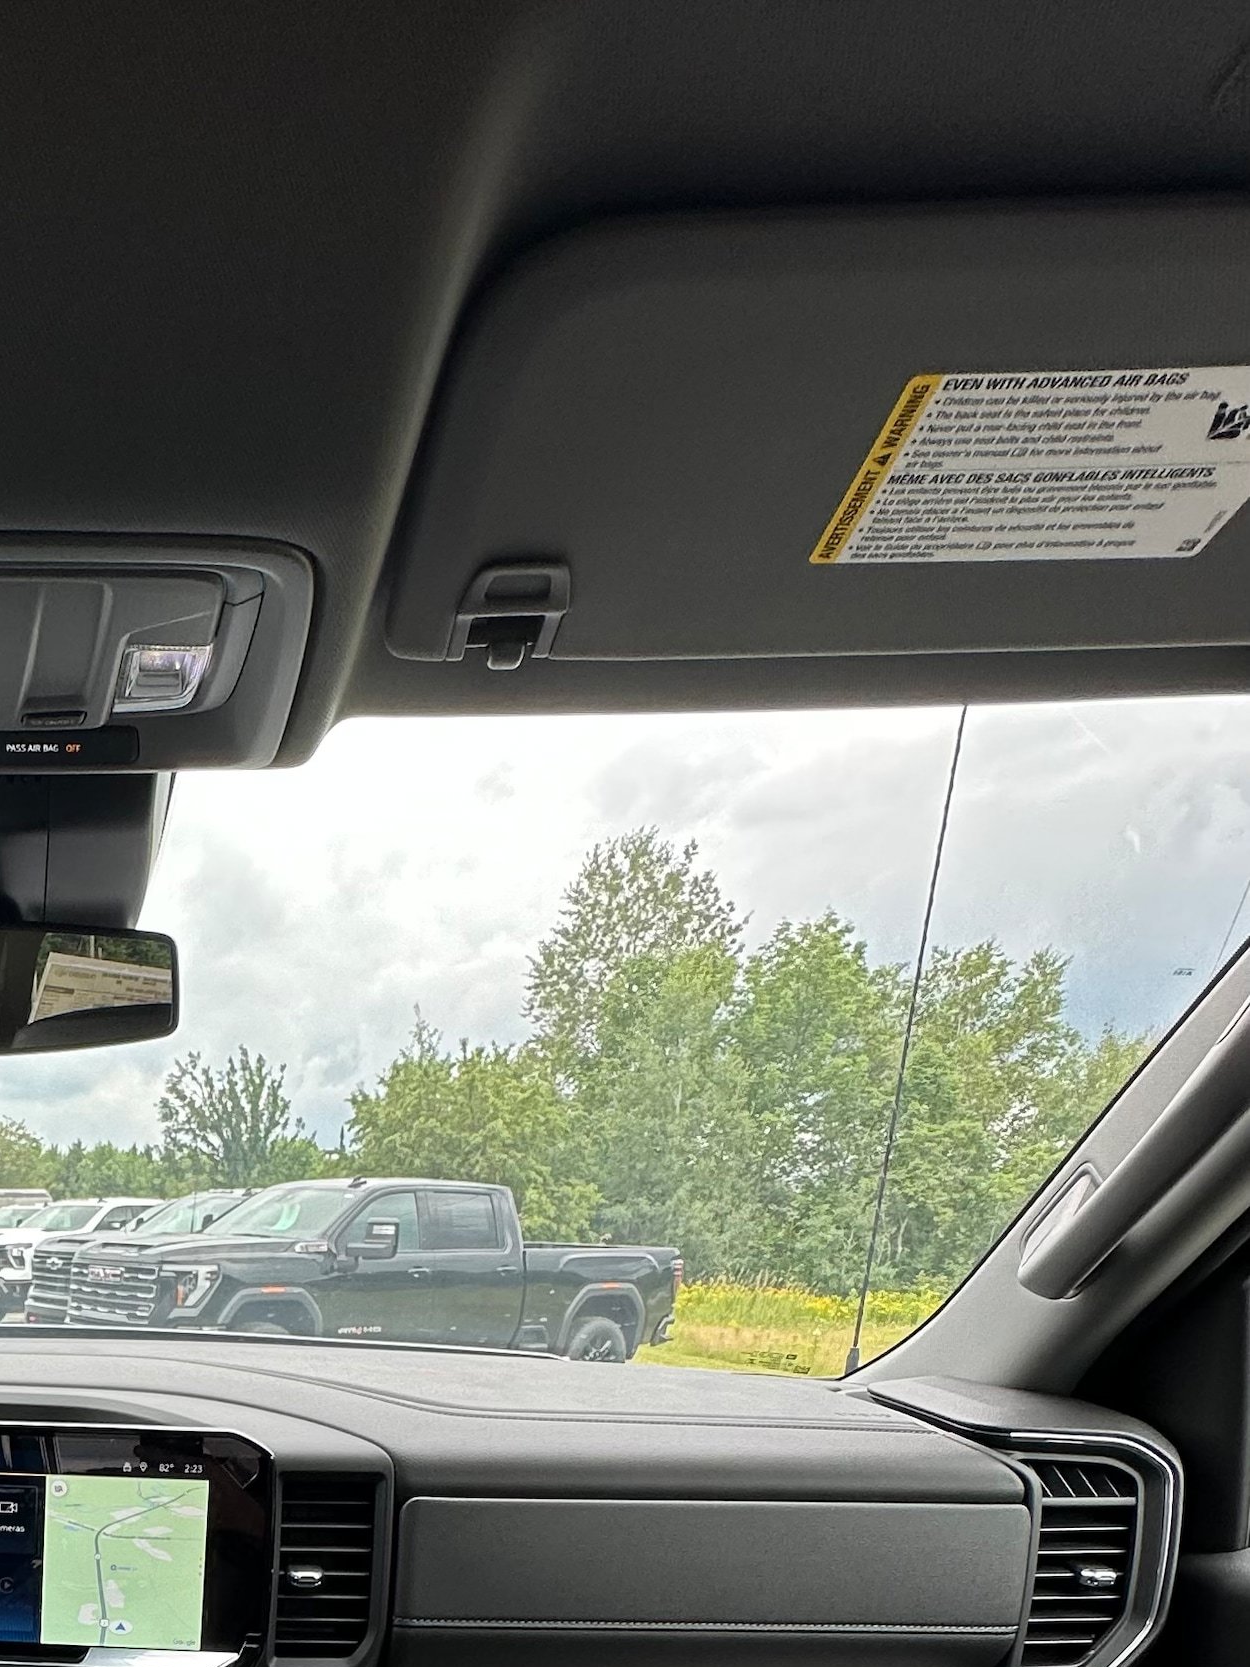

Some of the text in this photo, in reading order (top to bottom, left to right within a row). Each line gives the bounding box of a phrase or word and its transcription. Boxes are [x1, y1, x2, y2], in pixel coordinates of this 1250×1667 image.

[943, 372, 1190, 391] EVEN WITH ADVANCED AIR BAGS
[881, 383, 931, 449] WARNING
[929, 473, 966, 484] AVEC
[966, 473, 996, 484] DES
[994, 472, 1033, 483] SACS
[1120, 467, 1217, 480] INTELLIGENTS
[818, 470, 881, 559] AVERTISSEMENT
[6, 743, 81, 753] PASS AIR BAG OFF
[184, 1464, 203, 1473] 2:23
